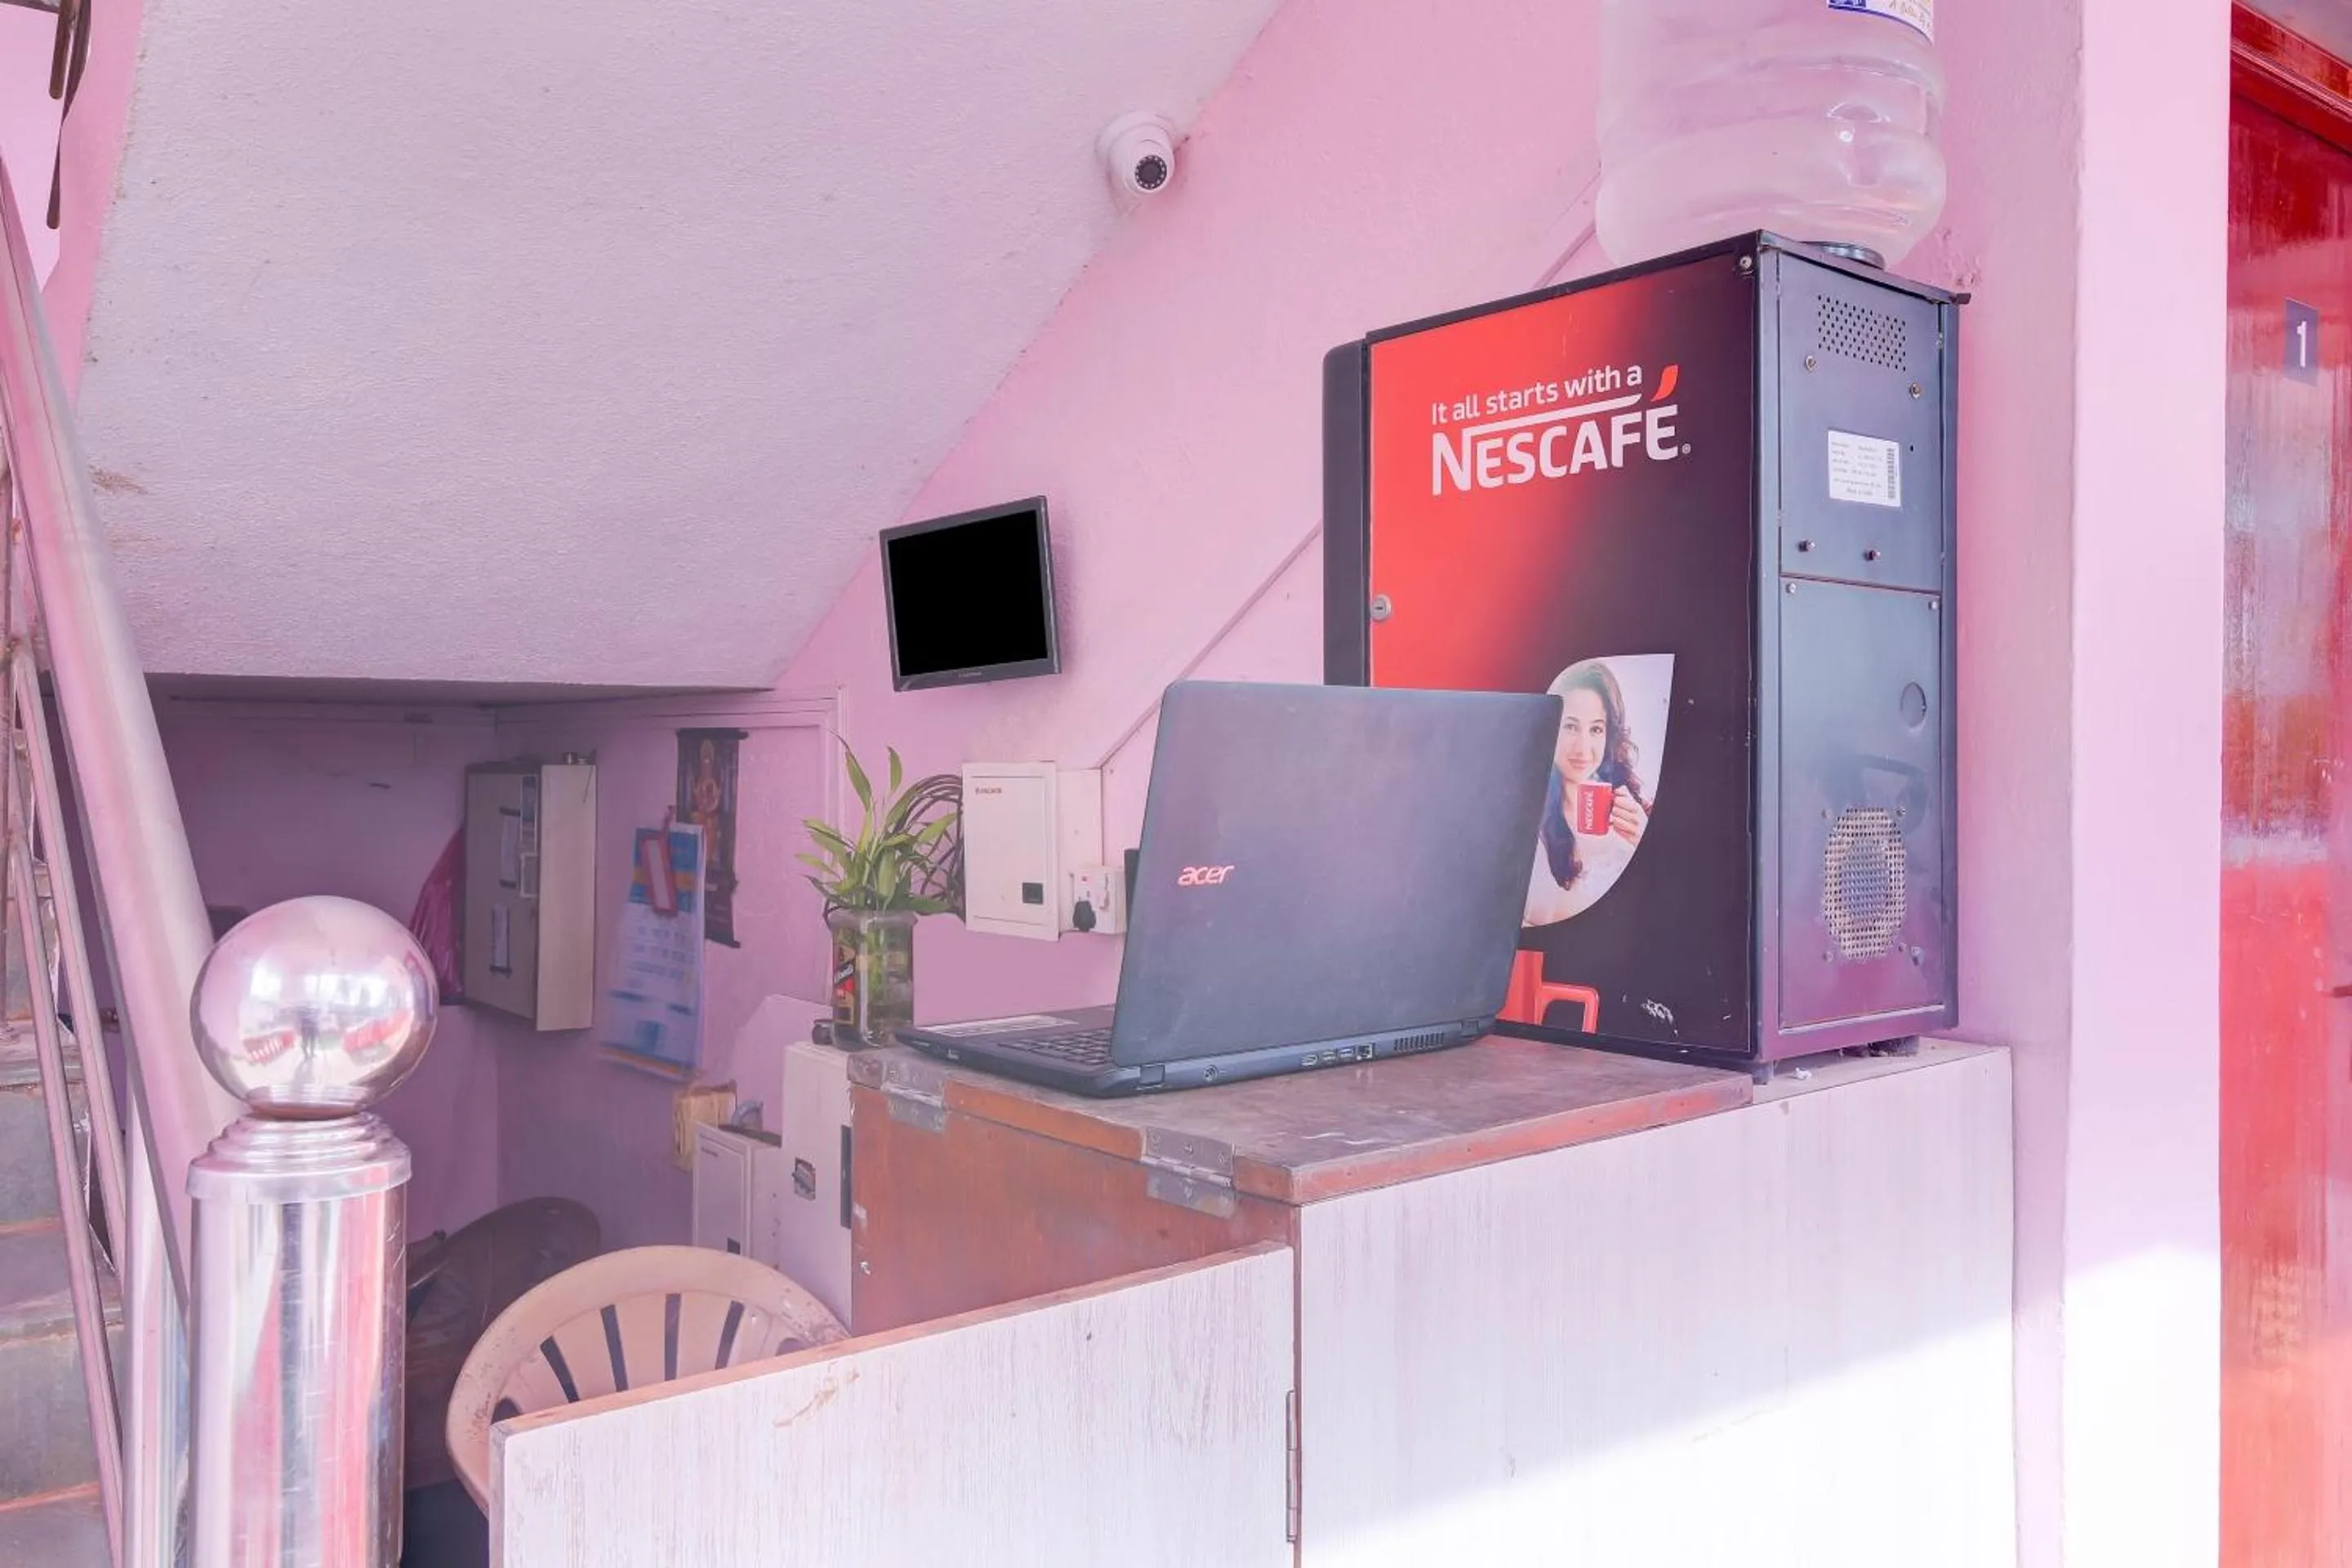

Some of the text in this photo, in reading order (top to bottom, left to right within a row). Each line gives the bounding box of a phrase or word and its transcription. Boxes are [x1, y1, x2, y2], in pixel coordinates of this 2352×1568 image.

[2296, 320, 2307, 368] 1
[1432, 364, 1643, 425] It all starts with a
[1178, 865, 1235, 885] acer
